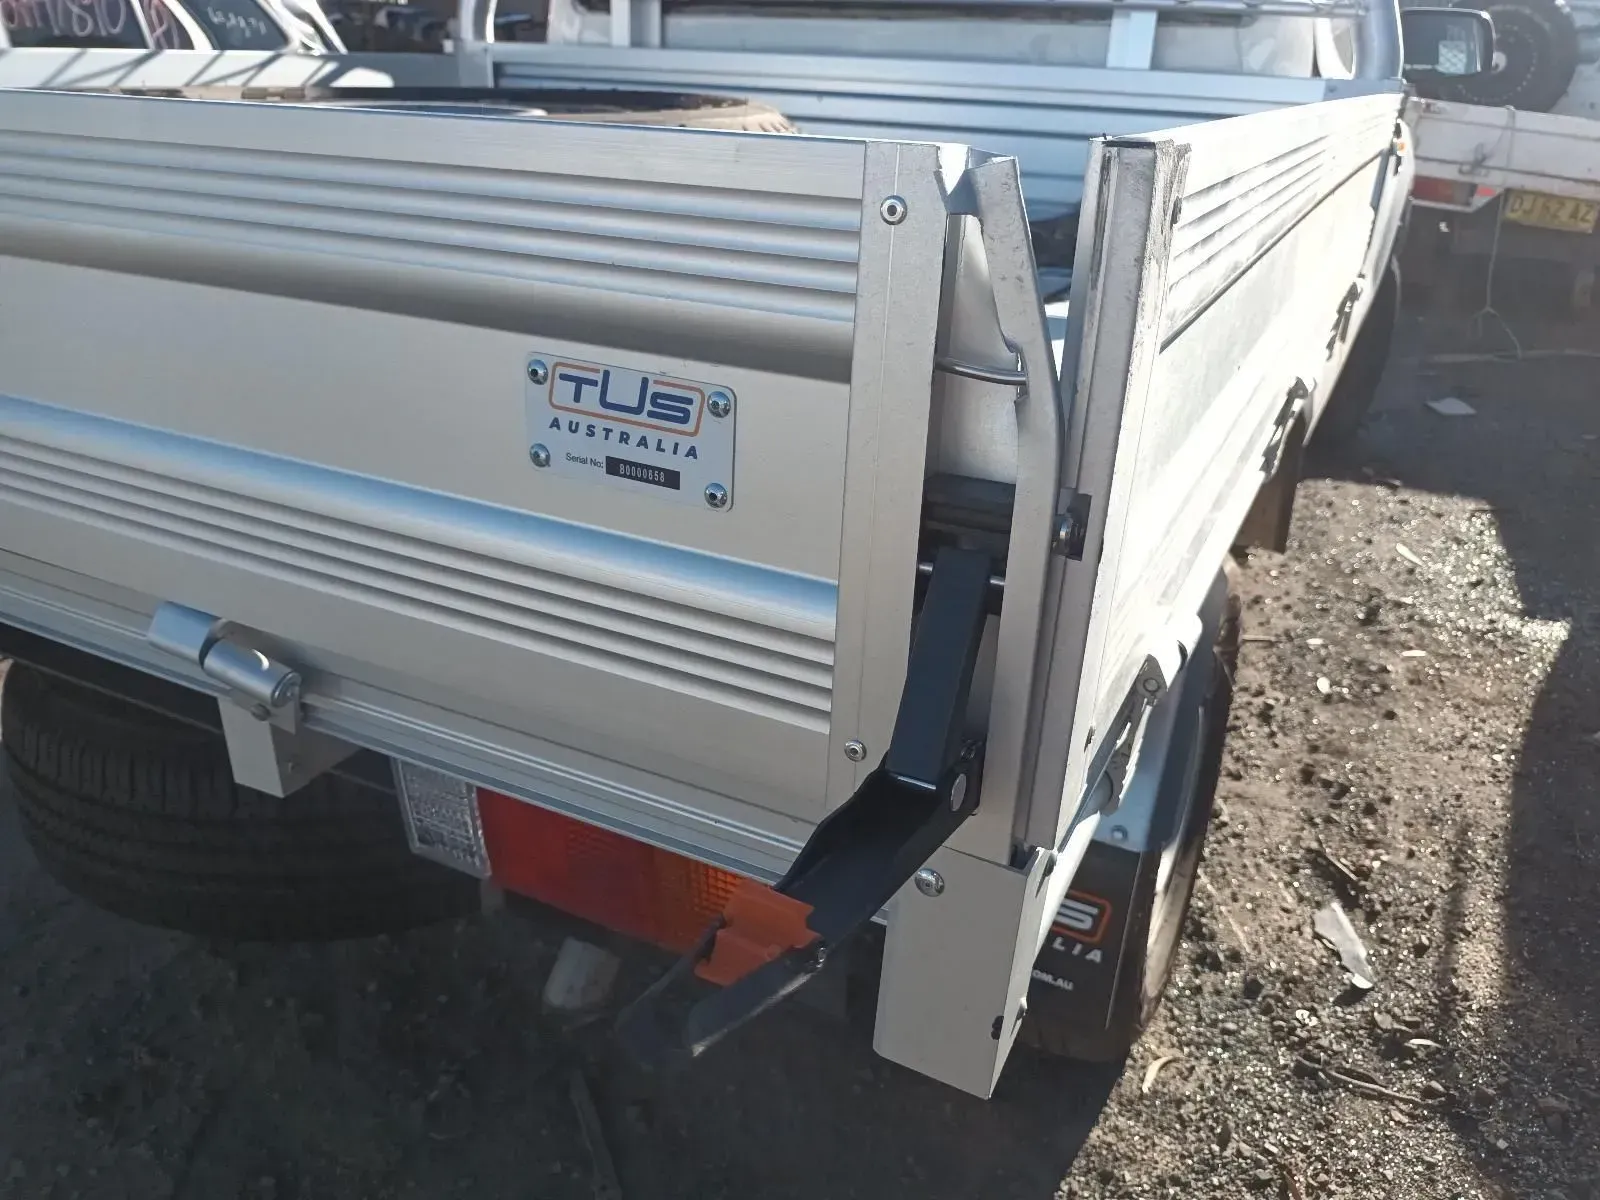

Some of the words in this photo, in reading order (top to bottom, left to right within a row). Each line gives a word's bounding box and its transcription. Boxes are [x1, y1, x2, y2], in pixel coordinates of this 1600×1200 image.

[559, 369, 693, 425] TUS
[549, 417, 698, 460] AUSTRALIA
[566, 452, 588, 464] Serial
[590, 458, 604, 468] No:
